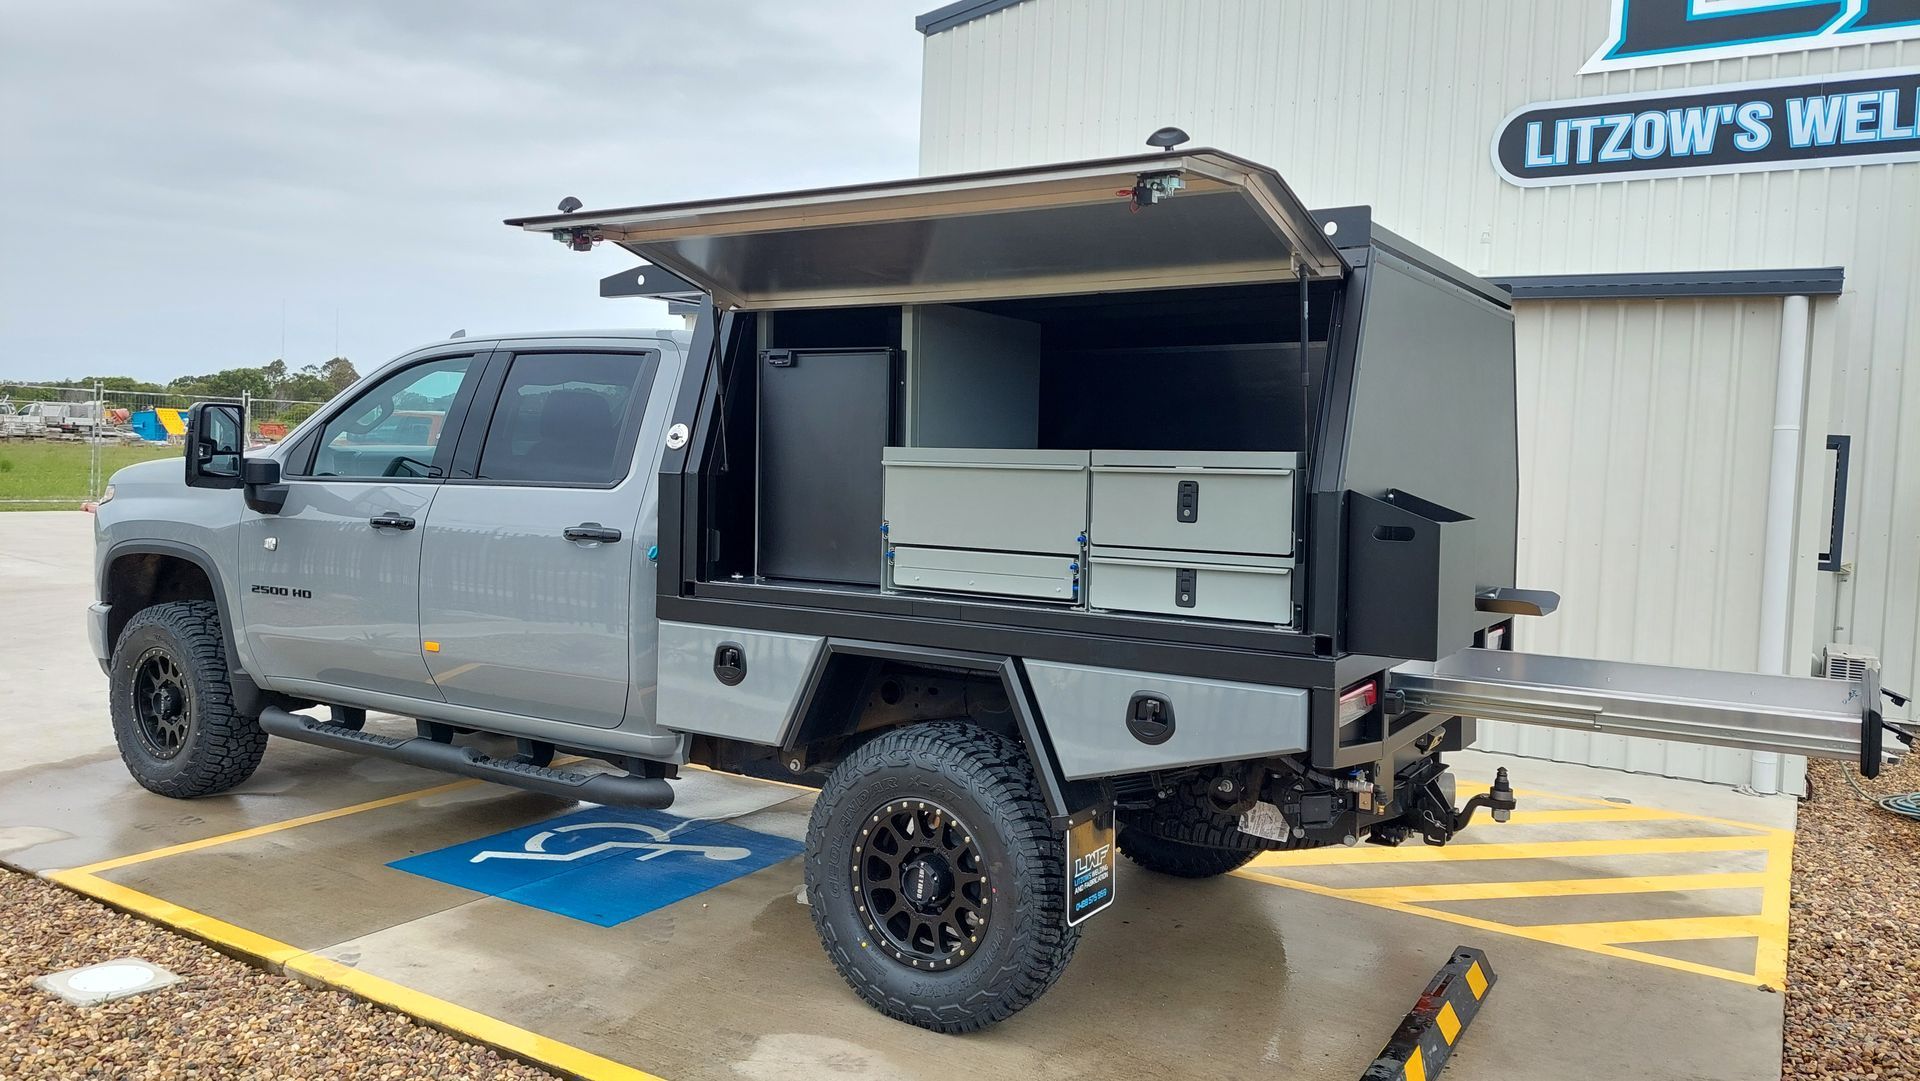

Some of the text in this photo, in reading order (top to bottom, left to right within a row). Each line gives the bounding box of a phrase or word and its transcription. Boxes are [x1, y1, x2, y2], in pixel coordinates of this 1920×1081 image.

[1524, 87, 1920, 168] LITZOW'S WEL
[251, 584, 312, 599] 2500 HD
[1074, 843, 1110, 878] LWF
[1092, 864, 1109, 877] WELDING
[1074, 871, 1109, 895] AND FABRICATION
